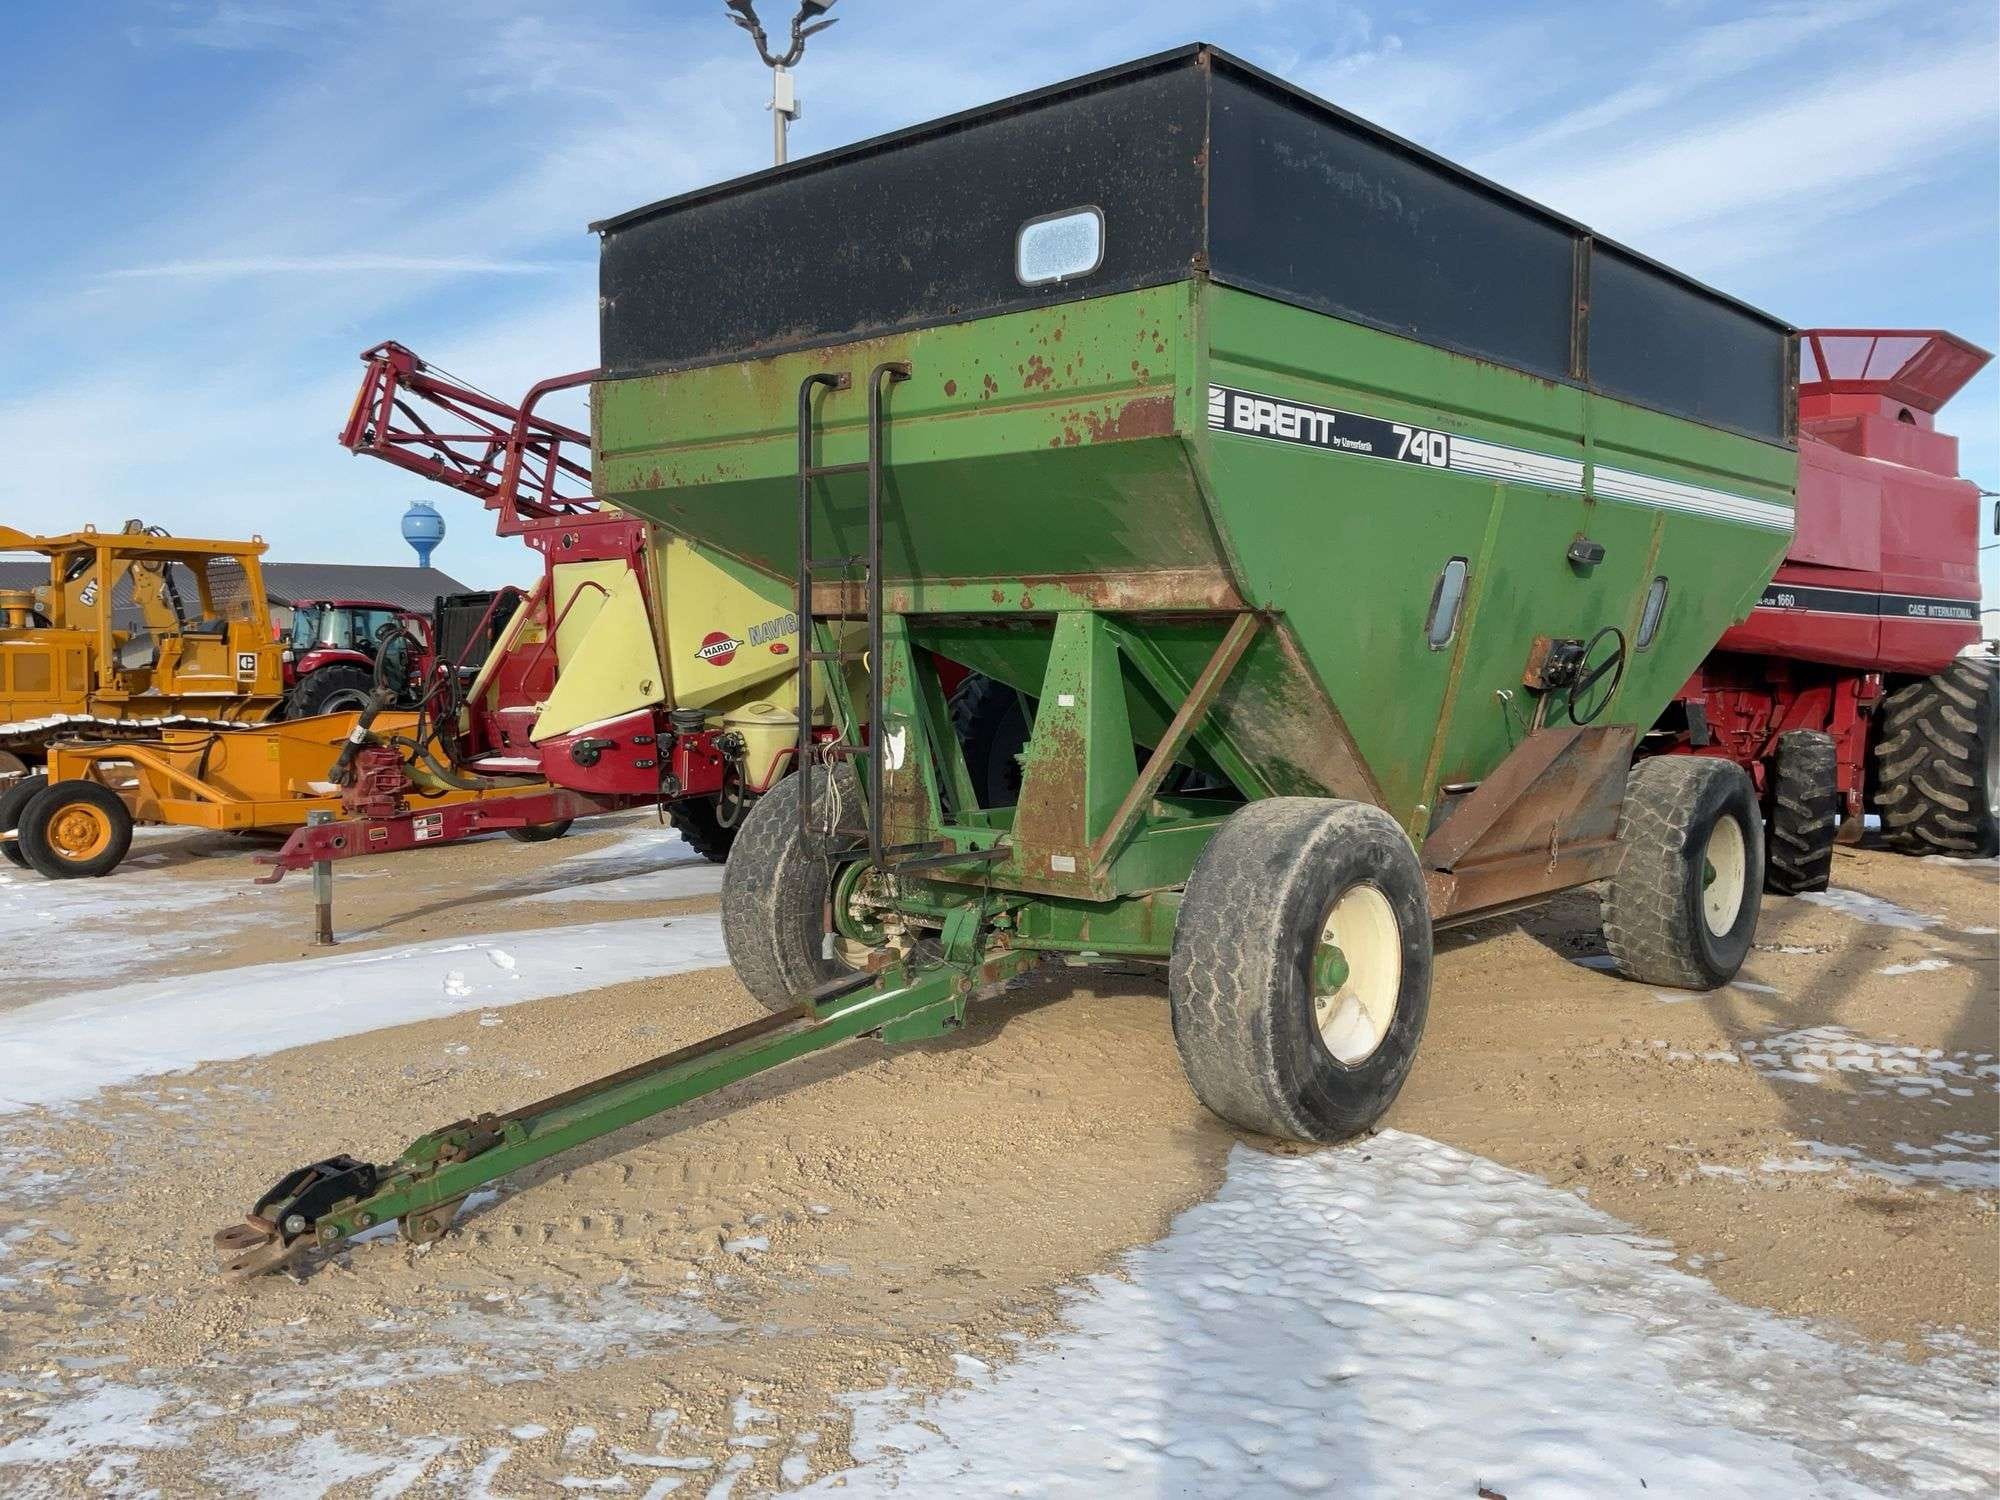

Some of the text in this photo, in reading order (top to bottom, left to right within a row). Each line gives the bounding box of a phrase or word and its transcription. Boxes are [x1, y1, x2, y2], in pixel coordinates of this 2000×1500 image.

[1233, 396, 1335, 443] BRENT
[1333, 435, 1341, 447] by
[1392, 425, 1448, 467] 740
[1778, 593, 1795, 607] 1660
[1908, 604, 1973, 619] CASE INTERNATIONAL
[703, 641, 734, 657] HARDI
